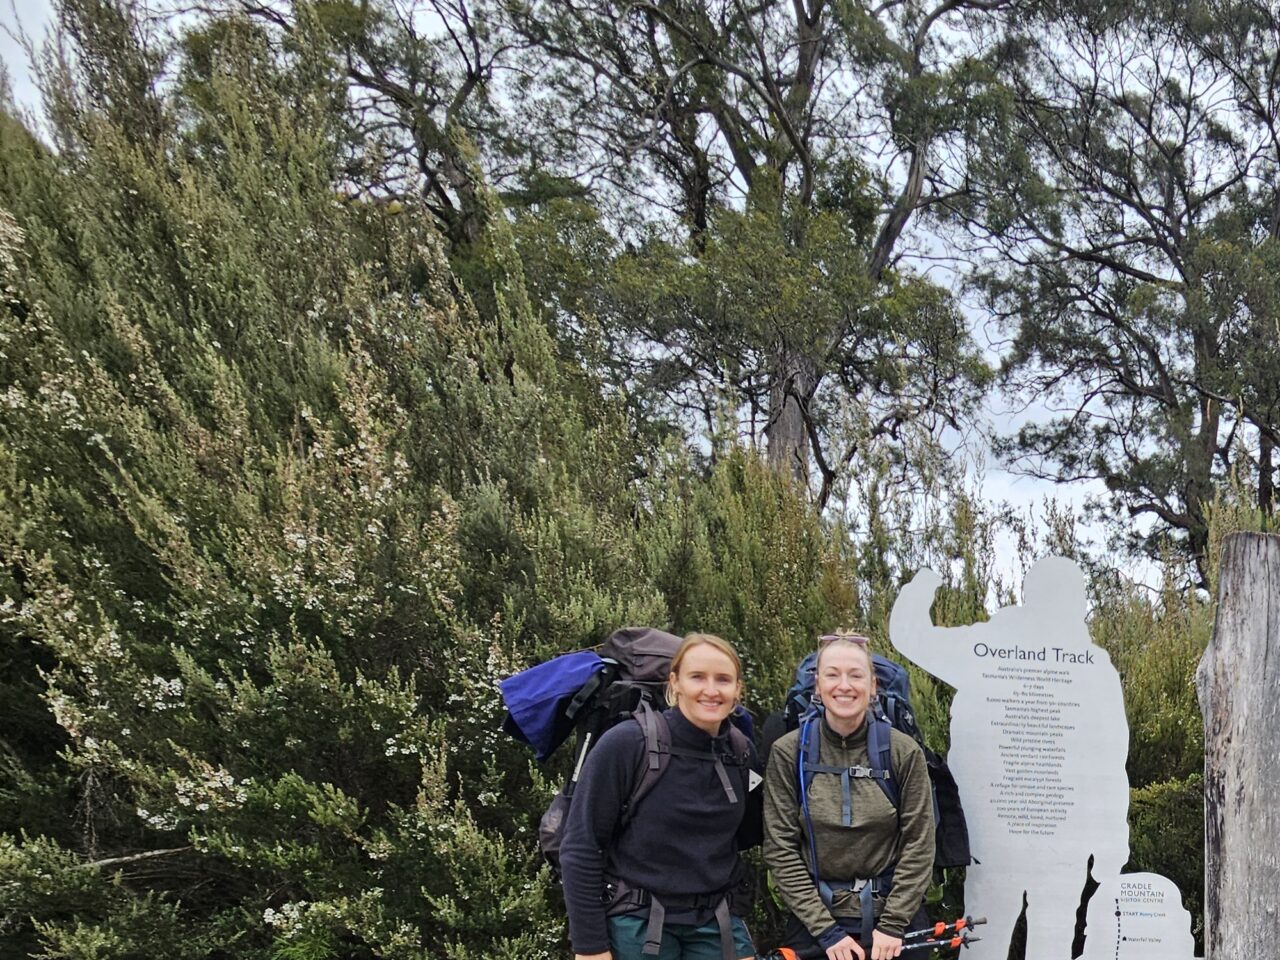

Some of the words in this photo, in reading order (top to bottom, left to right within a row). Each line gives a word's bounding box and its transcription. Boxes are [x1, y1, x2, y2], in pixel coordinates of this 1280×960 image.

[973, 642, 1046, 661] Overland
[1051, 647, 1095, 664] Track
[1120, 882, 1152, 890] CRADLE
[1120, 890, 1164, 898] MOUNTAIN
